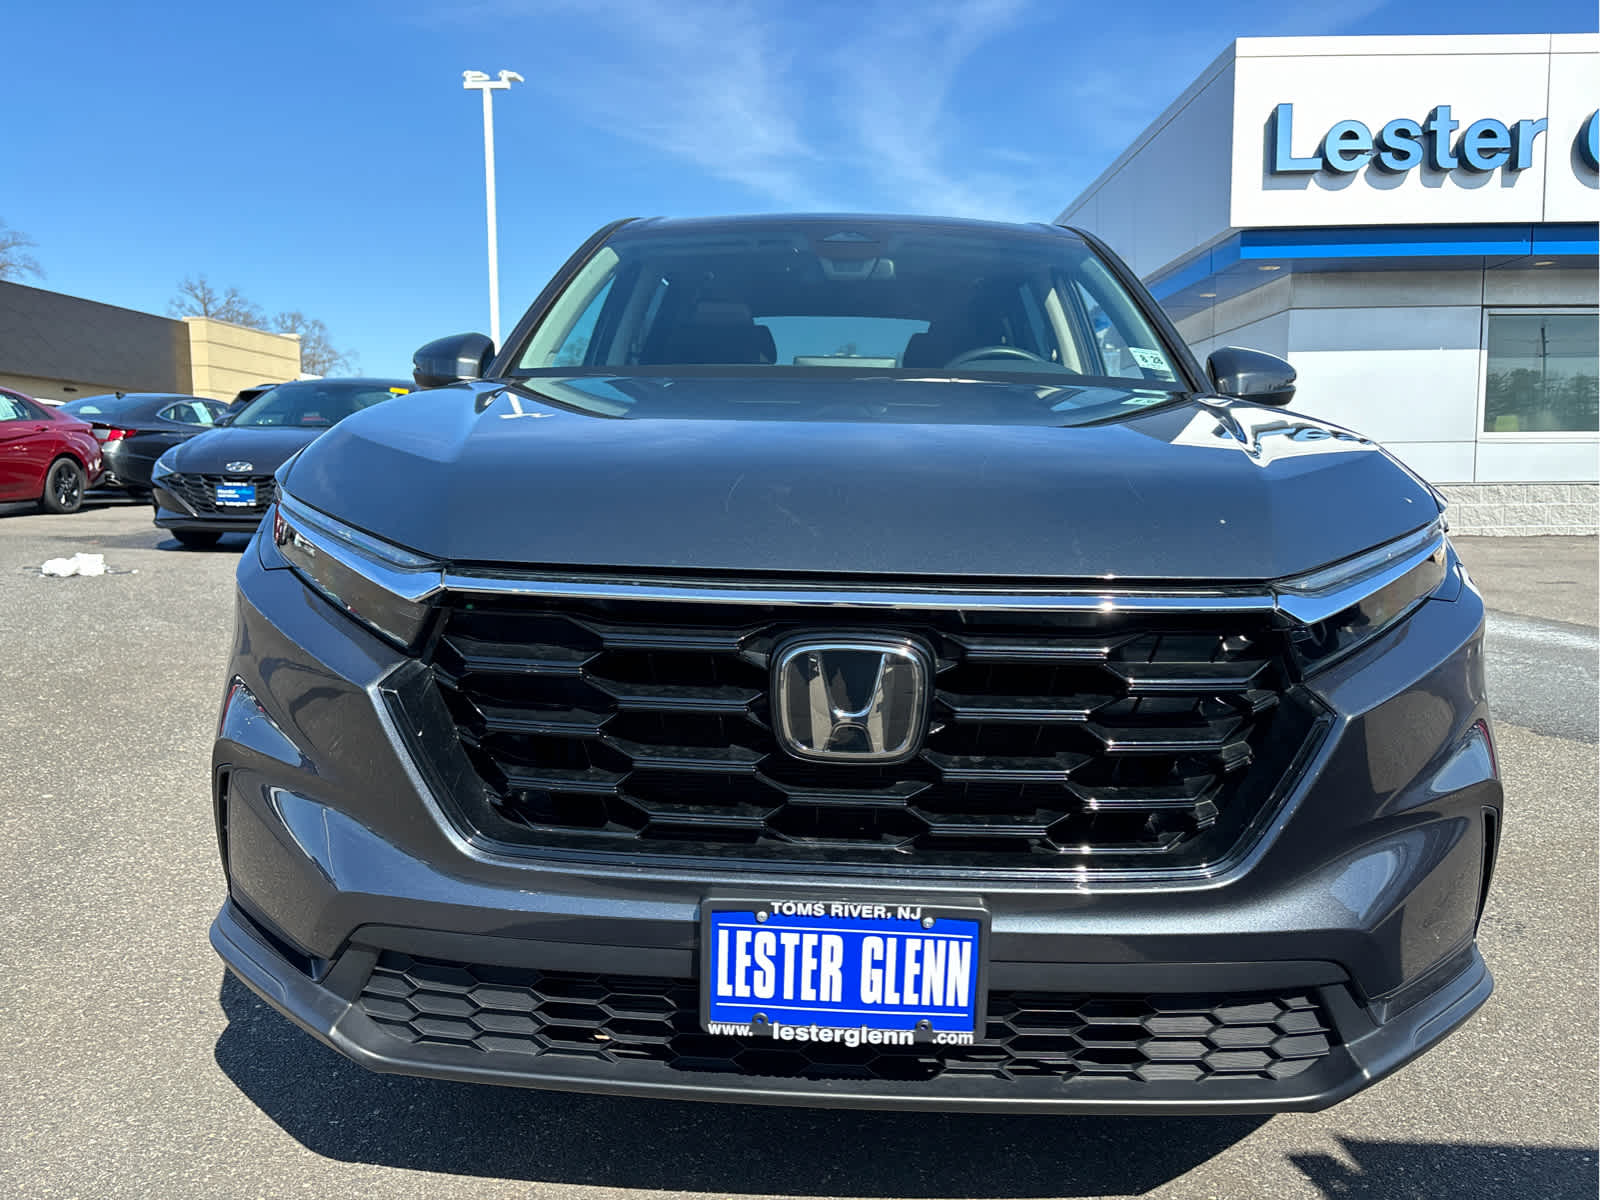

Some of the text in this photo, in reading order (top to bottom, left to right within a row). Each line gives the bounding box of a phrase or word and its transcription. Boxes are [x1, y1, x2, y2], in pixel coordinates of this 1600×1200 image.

[1272, 103, 1548, 173] Lester
[771, 901, 921, 921] TOMS RIVER, NJ
[716, 928, 973, 1008] LESTER GLENN
[708, 1022, 974, 1048] www. lesterglenn .com
